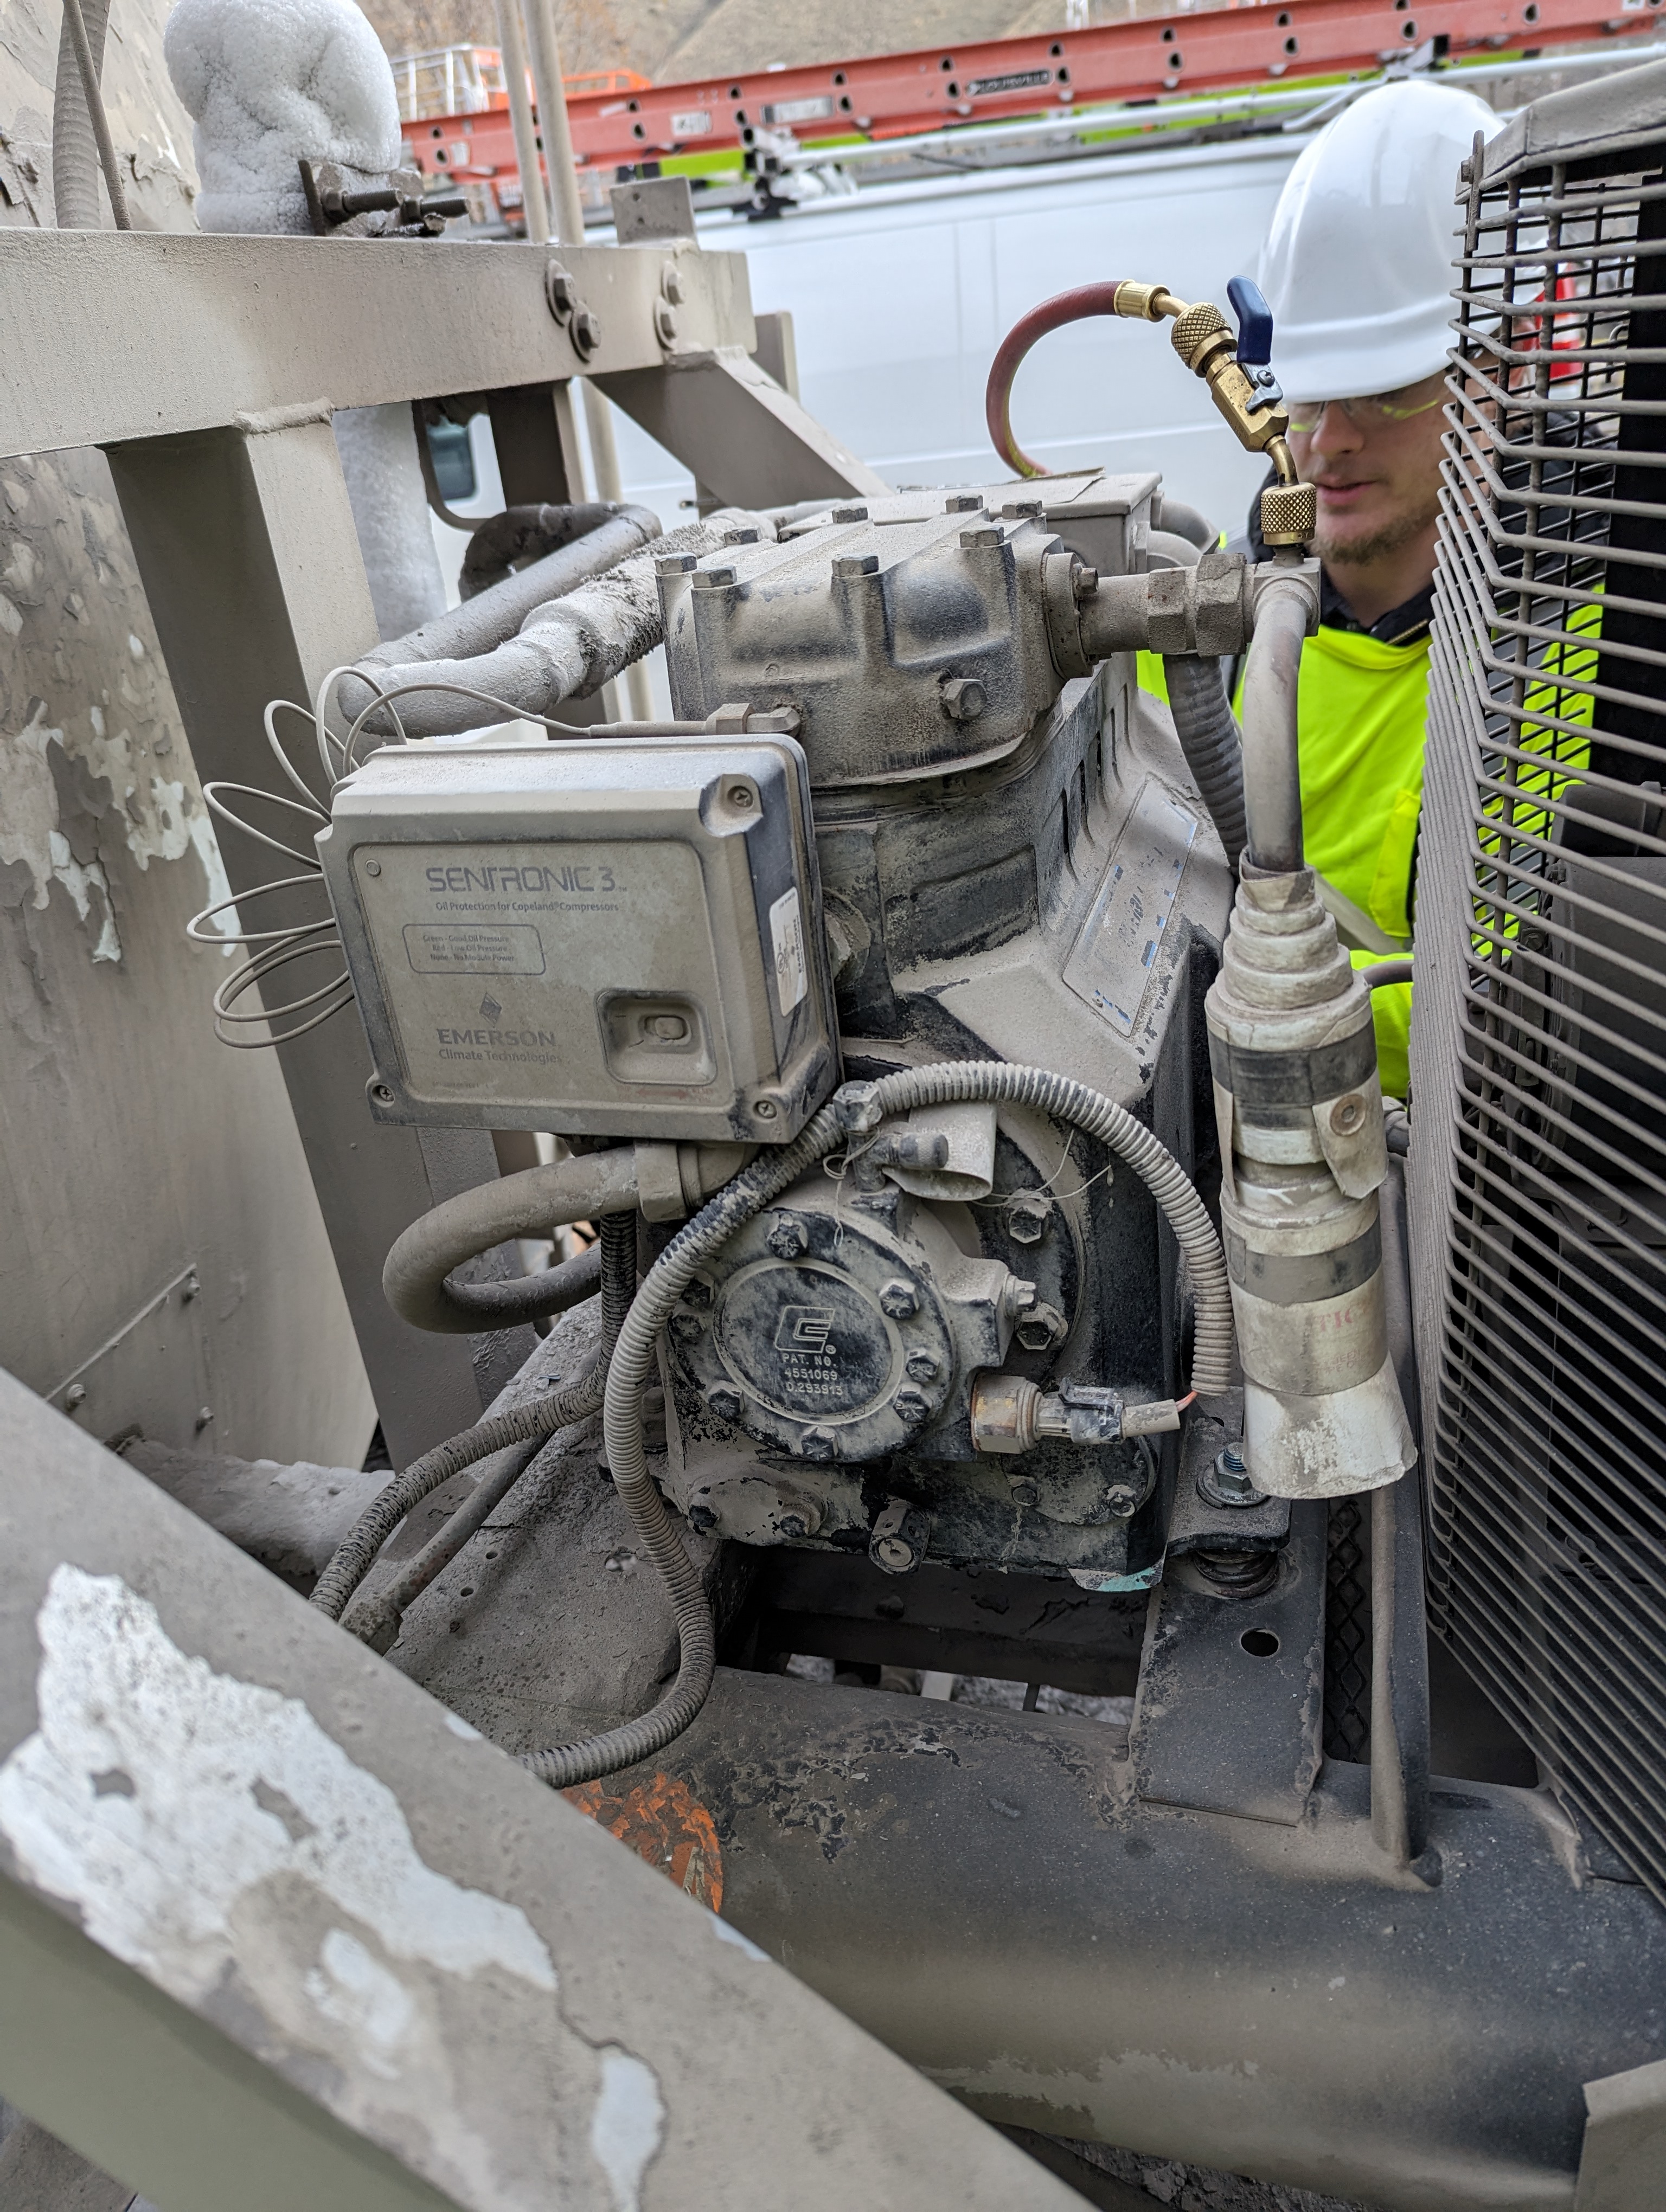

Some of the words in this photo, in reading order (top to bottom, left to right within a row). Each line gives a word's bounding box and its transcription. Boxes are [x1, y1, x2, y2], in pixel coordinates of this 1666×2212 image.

[426, 867, 595, 892] SENTRONIC
[436, 902, 448, 911] Oil
[450, 902, 496, 911] Protection
[497, 902, 510, 911] for
[559, 902, 619, 912] Compressors
[436, 1028, 556, 1047] EMERSON
[438, 1048, 483, 1061] Climate
[782, 1353, 810, 1365] PAT.
[814, 1355, 837, 1367] NO.
[784, 1367, 838, 1381] 4551069
